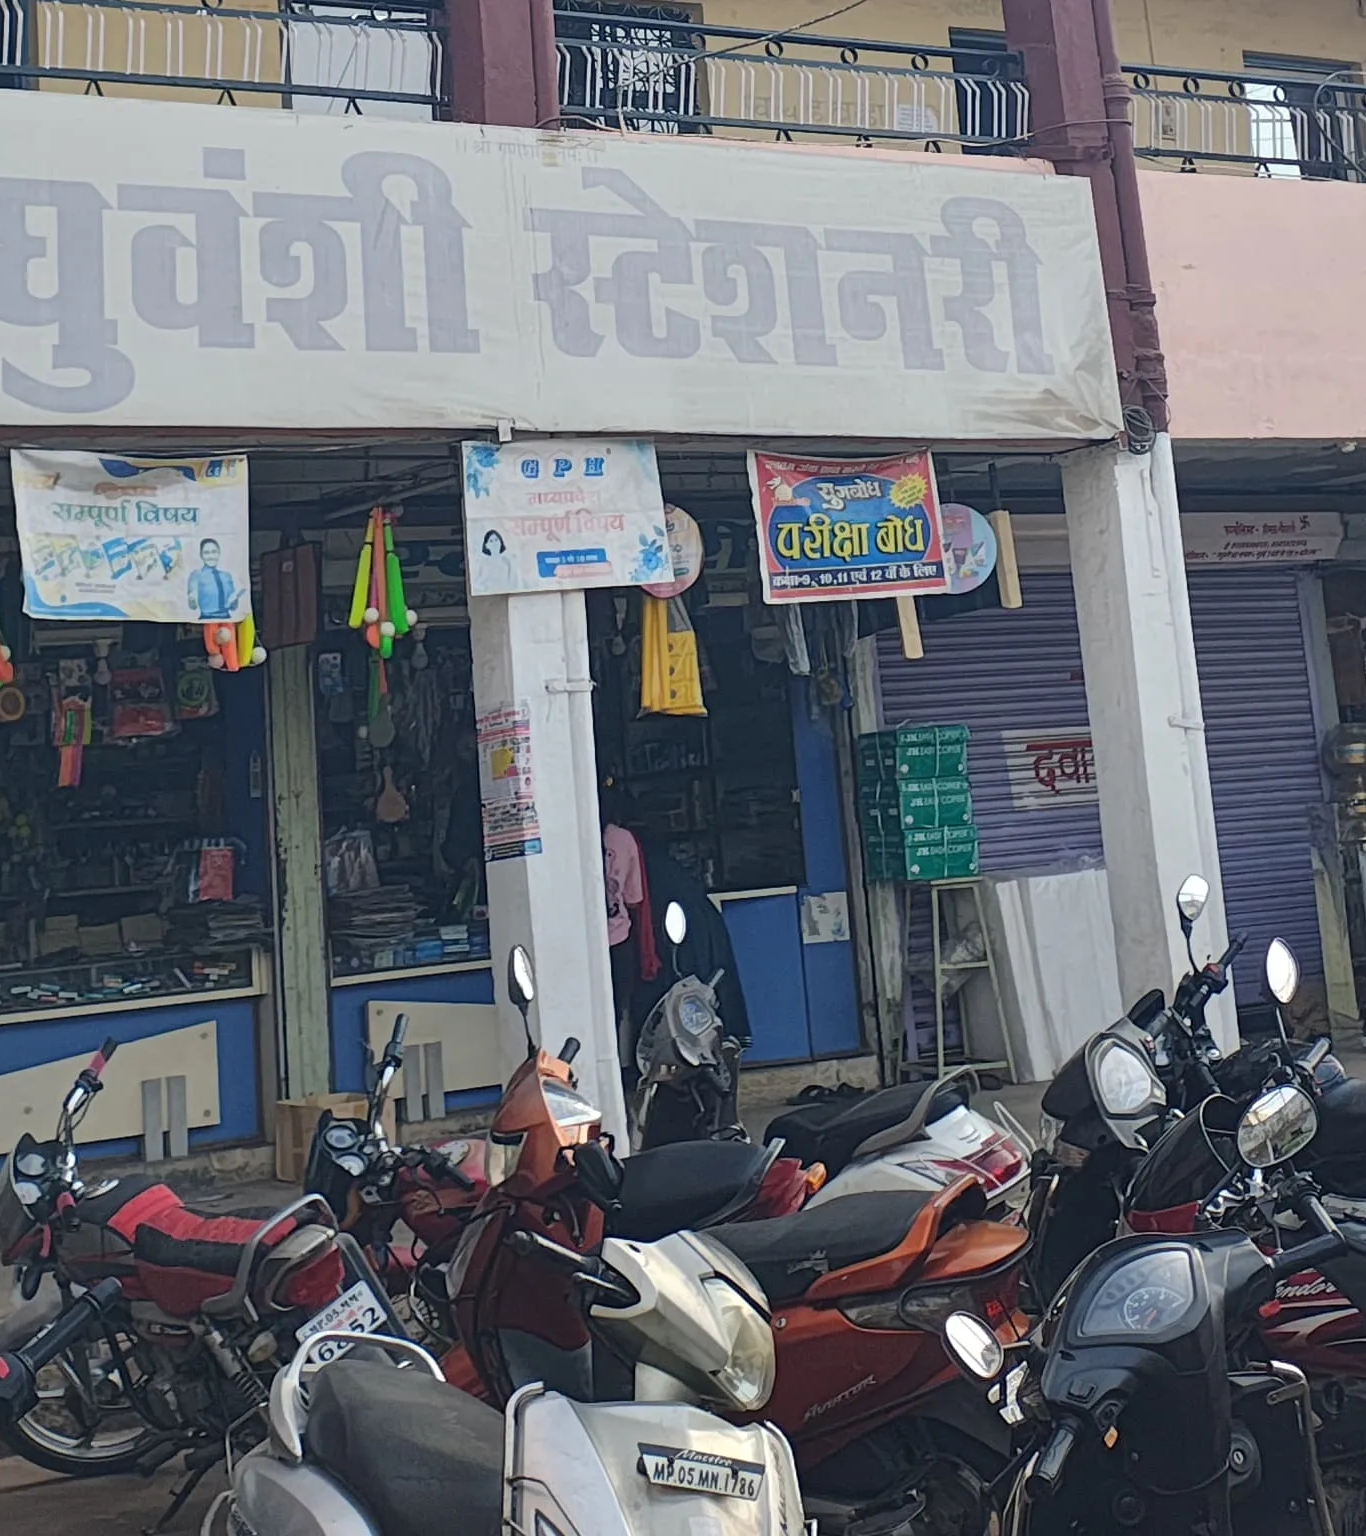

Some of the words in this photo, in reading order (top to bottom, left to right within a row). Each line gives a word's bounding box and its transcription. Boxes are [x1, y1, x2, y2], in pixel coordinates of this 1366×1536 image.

[523, 165, 1055, 376] स्टेशनरी
[816, 477, 882, 510] युगबोध
[51, 500, 127, 532] सम्पूर्ण
[135, 500, 201, 525] विषय
[875, 514, 925, 555] बोध
[870, 570, 883, 581] 12
[1275, 1275, 1338, 1298] endor
[674, 1449, 733, 1466] Maestro
